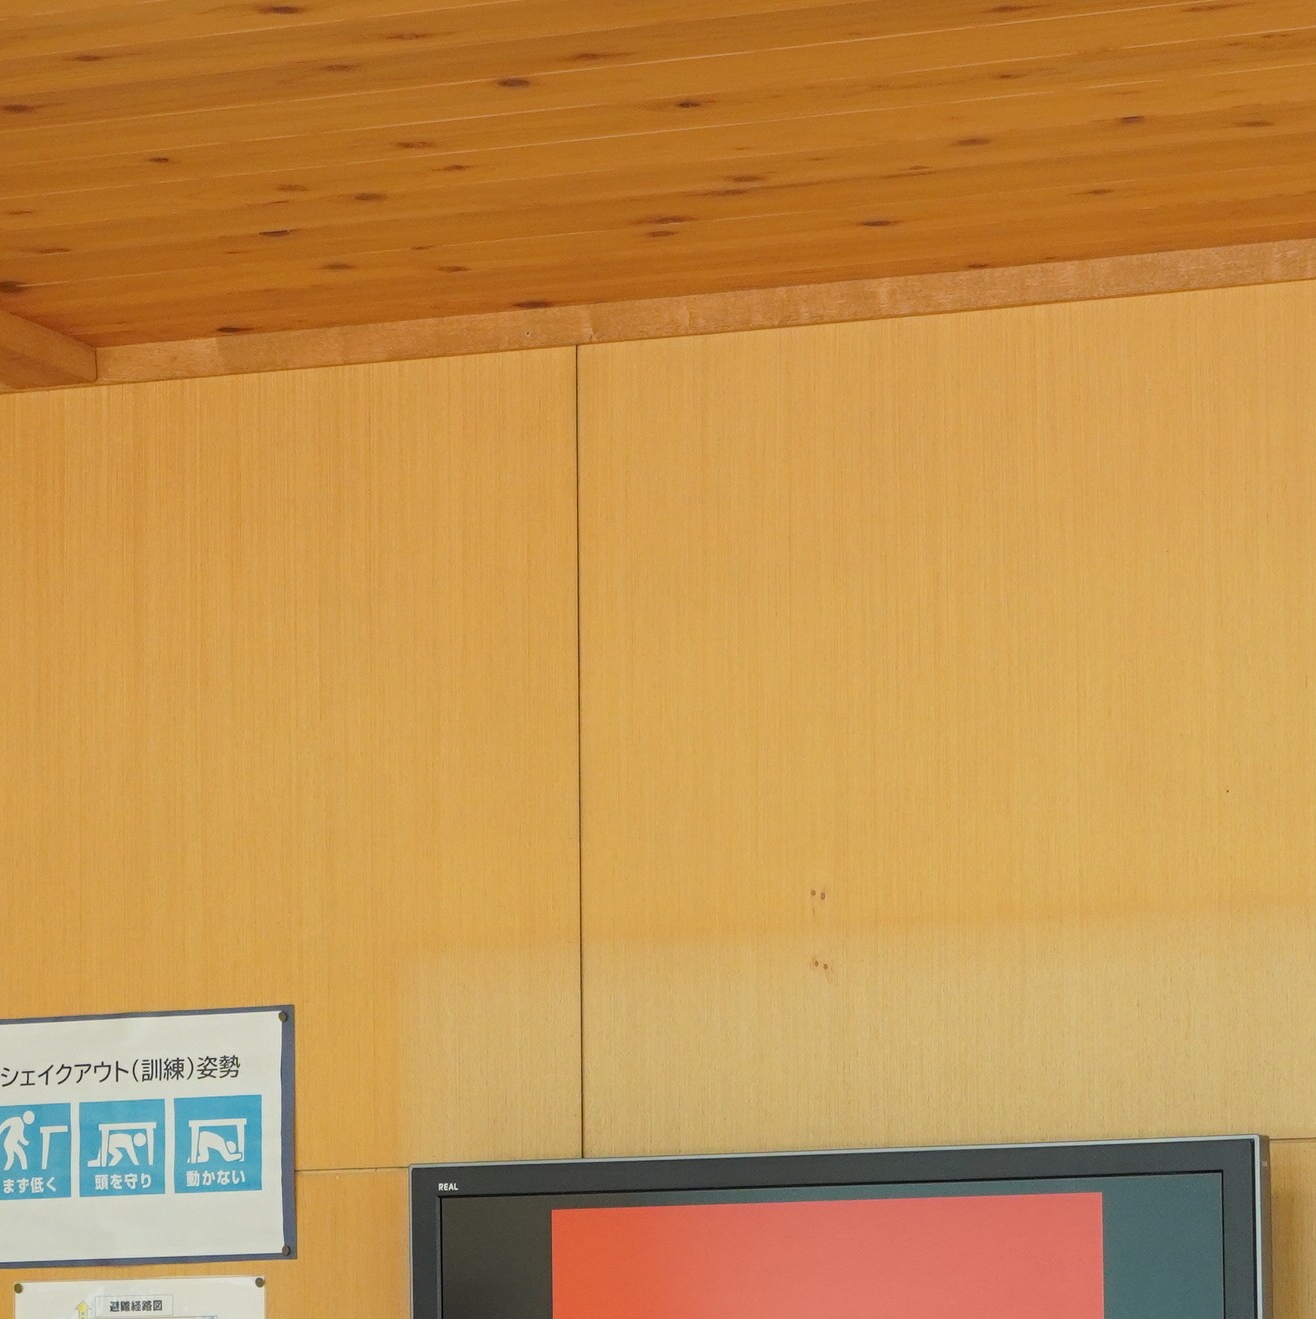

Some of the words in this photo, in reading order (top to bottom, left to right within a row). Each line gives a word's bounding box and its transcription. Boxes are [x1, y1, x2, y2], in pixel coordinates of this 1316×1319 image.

[0, 1054, 241, 1088] シェイクアウト(訓練)姿勢
[2, 1176, 57, 1194] まず低く
[94, 1172, 152, 1191] 頭を守り
[185, 1169, 246, 1188] 動かない
[438, 1183, 459, 1191] REAL
[110, 1300, 162, 1312] 避難経路図
